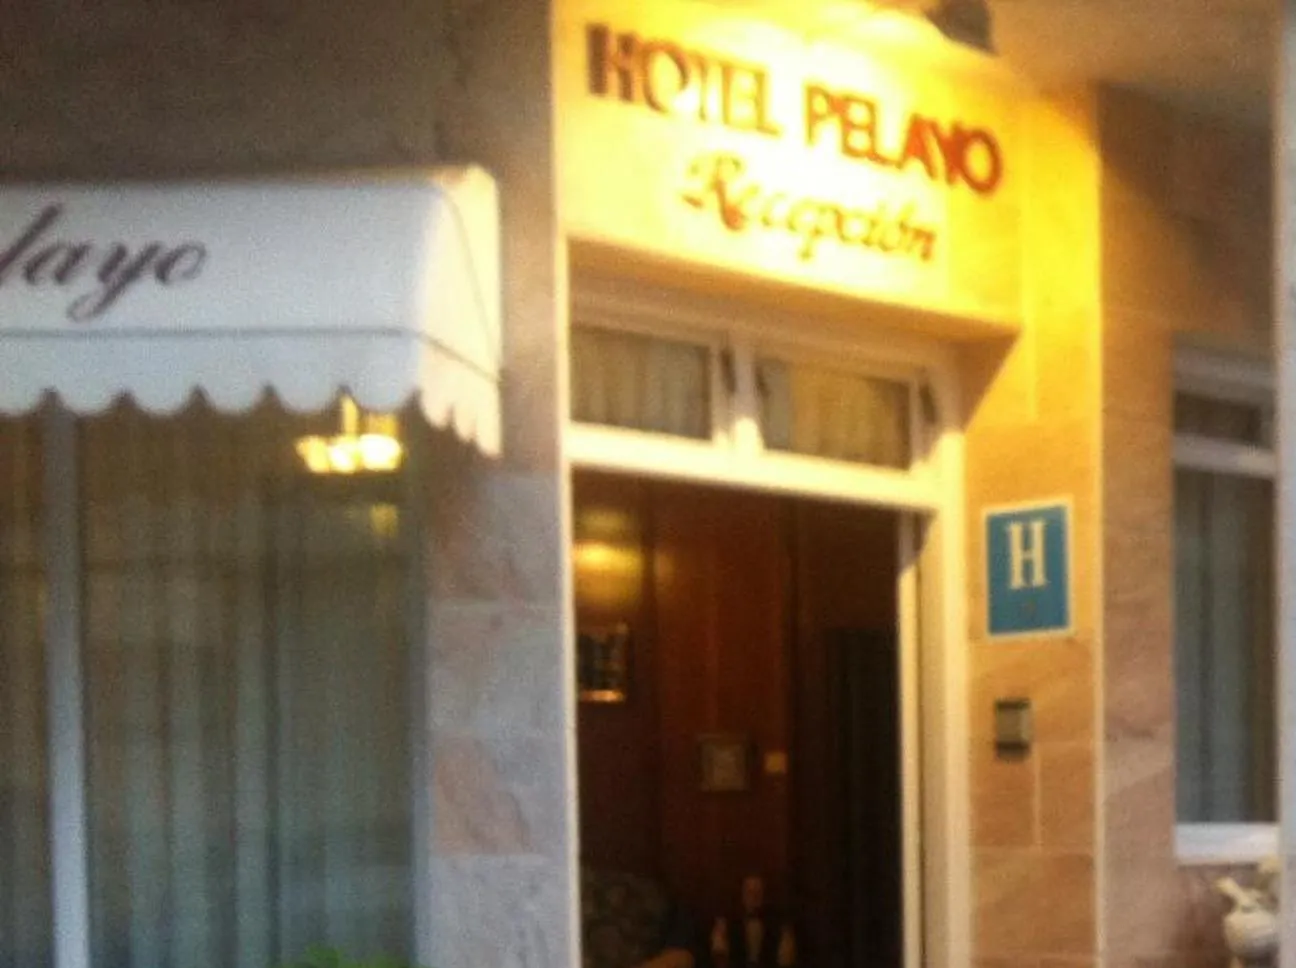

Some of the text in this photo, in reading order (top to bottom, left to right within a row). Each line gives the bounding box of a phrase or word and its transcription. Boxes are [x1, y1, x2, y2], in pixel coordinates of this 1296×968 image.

[585, 24, 1003, 196] HOTEL PELAYO
[1007, 518, 1046, 590] H
